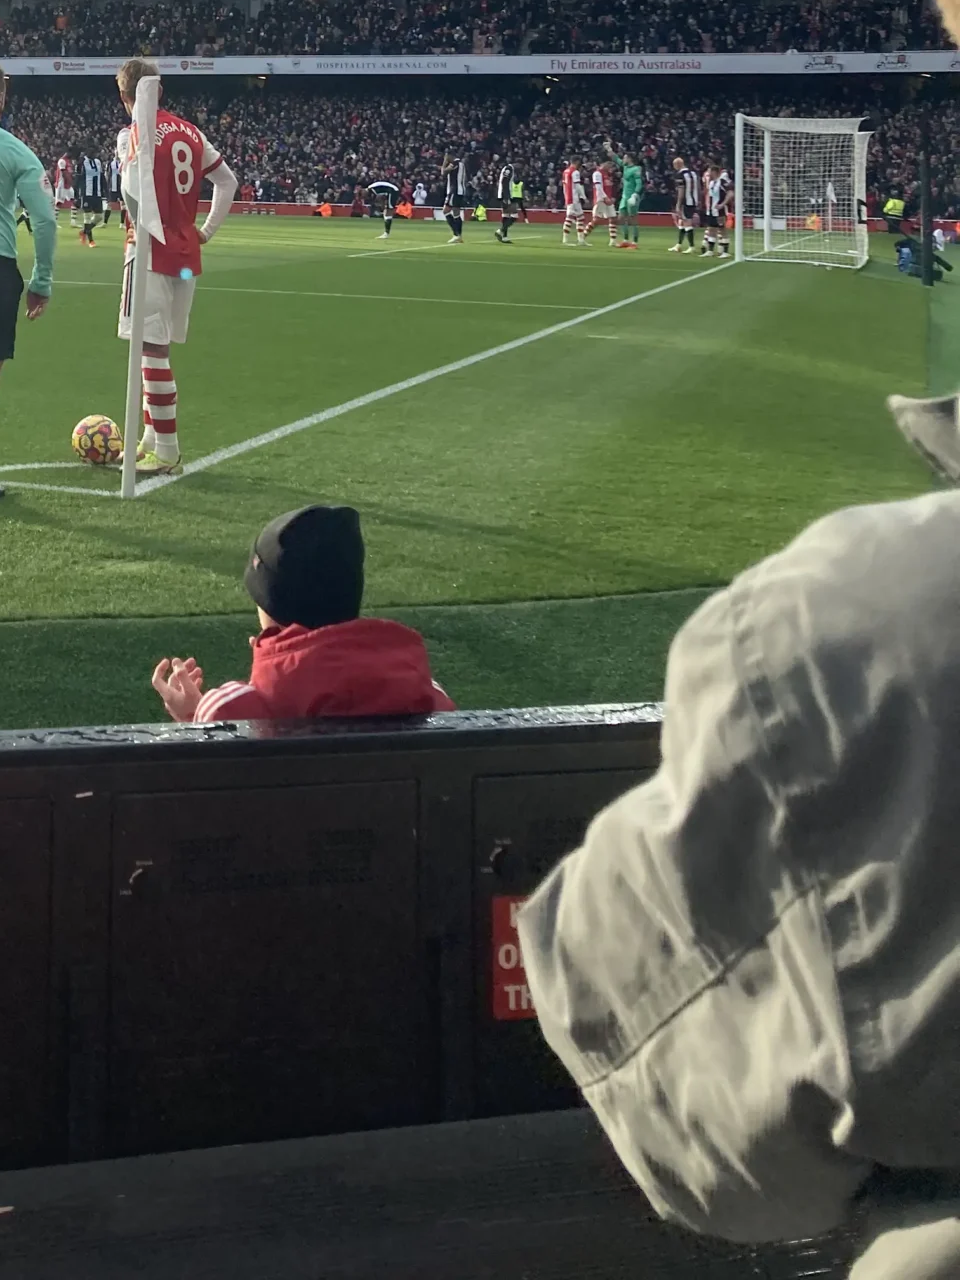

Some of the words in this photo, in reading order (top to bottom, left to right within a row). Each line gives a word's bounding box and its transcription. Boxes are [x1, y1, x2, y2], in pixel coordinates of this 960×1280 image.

[551, 59, 567, 70] Fly
[571, 59, 618, 70] Emirates
[623, 60, 634, 70] to
[638, 59, 701, 70] Australasia
[171, 140, 195, 195] 8
